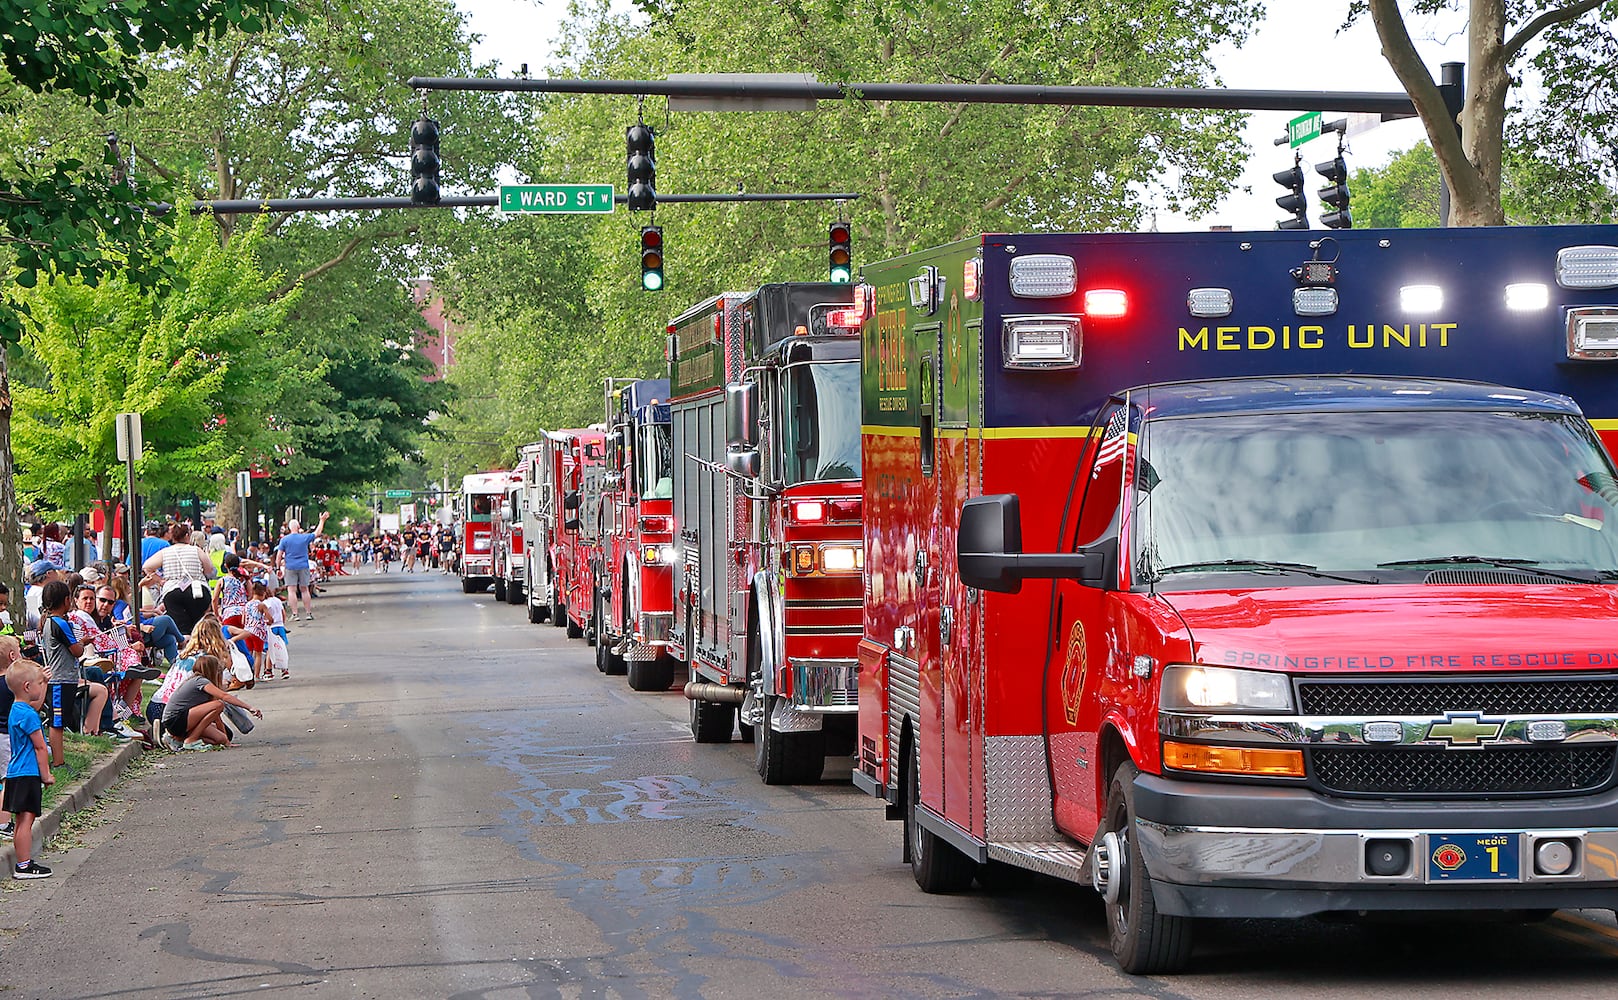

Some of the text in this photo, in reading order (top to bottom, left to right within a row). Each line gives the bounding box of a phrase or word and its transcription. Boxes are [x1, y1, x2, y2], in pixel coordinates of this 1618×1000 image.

[506, 191, 608, 206] E WARD ST W
[878, 307, 907, 391] FIRE
[1178, 323, 1457, 351] MEDIC UNIT
[1223, 650, 1395, 669] SPRINGFIELD
[1406, 655, 1462, 667] FIRE
[1473, 653, 1577, 667] RESCUE
[1486, 847, 1498, 872] 1
